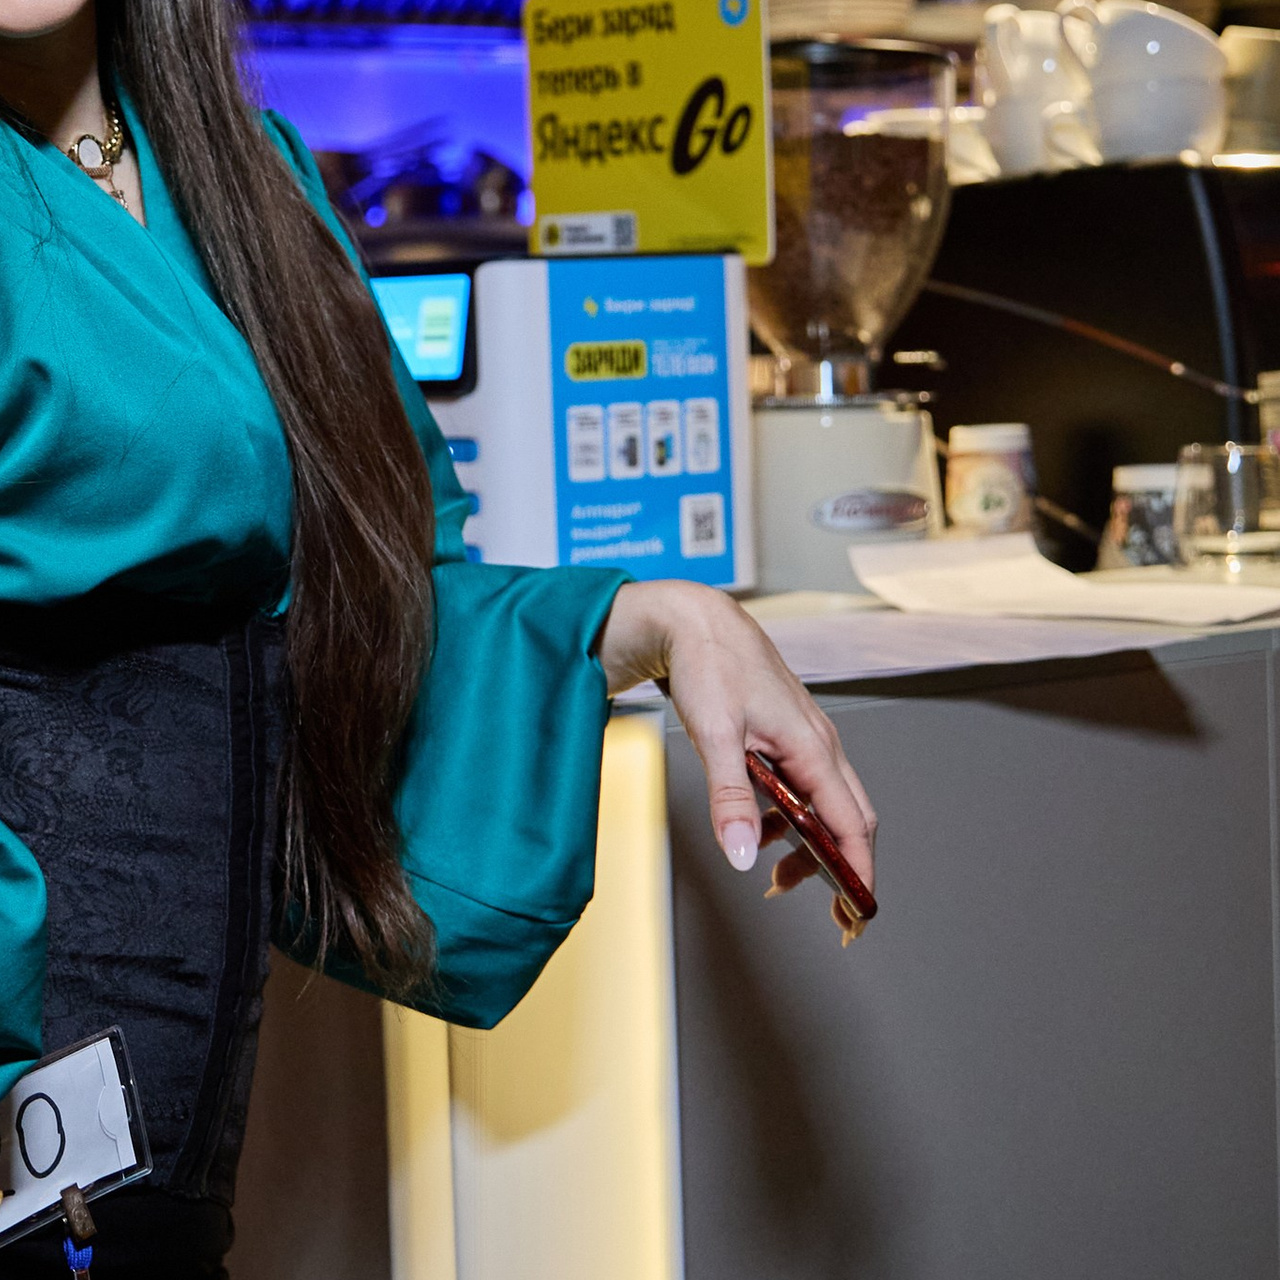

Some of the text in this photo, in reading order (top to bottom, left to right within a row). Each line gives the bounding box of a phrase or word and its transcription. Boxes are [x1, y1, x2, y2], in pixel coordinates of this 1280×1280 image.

[627, 60, 642, 87] в
[537, 76, 752, 176] Яндекс Go
